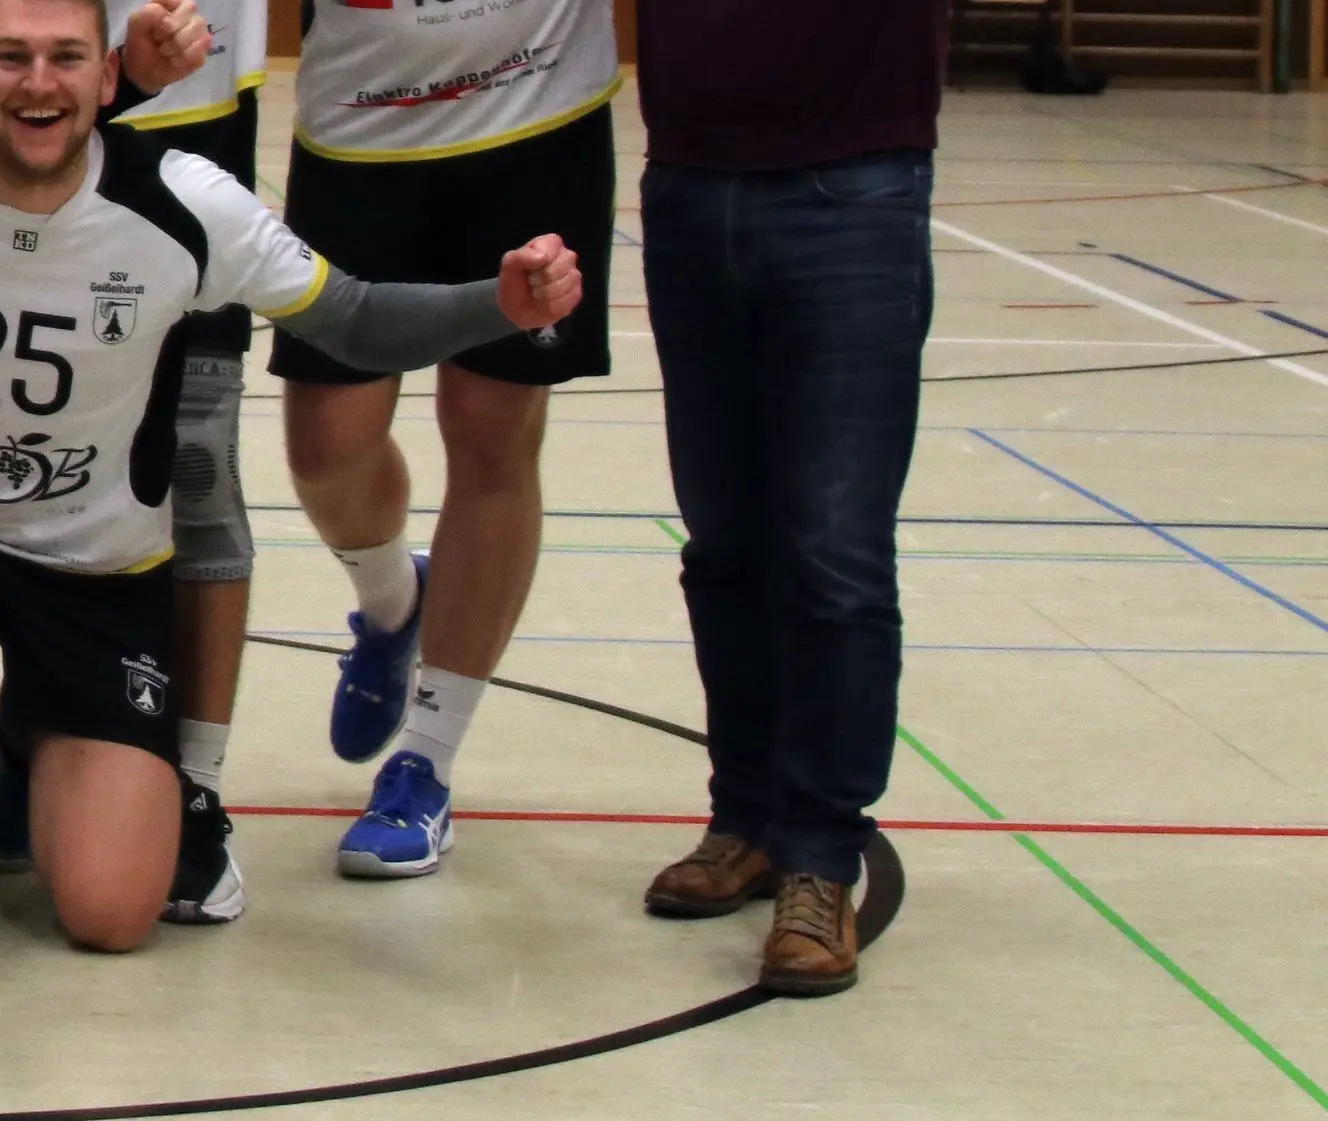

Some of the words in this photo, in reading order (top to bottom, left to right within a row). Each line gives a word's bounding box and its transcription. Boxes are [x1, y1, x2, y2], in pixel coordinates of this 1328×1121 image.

[459, 8, 484, 20] und
[109, 271, 129, 282] SSV
[91, 282, 145, 295] Geißelhardt
